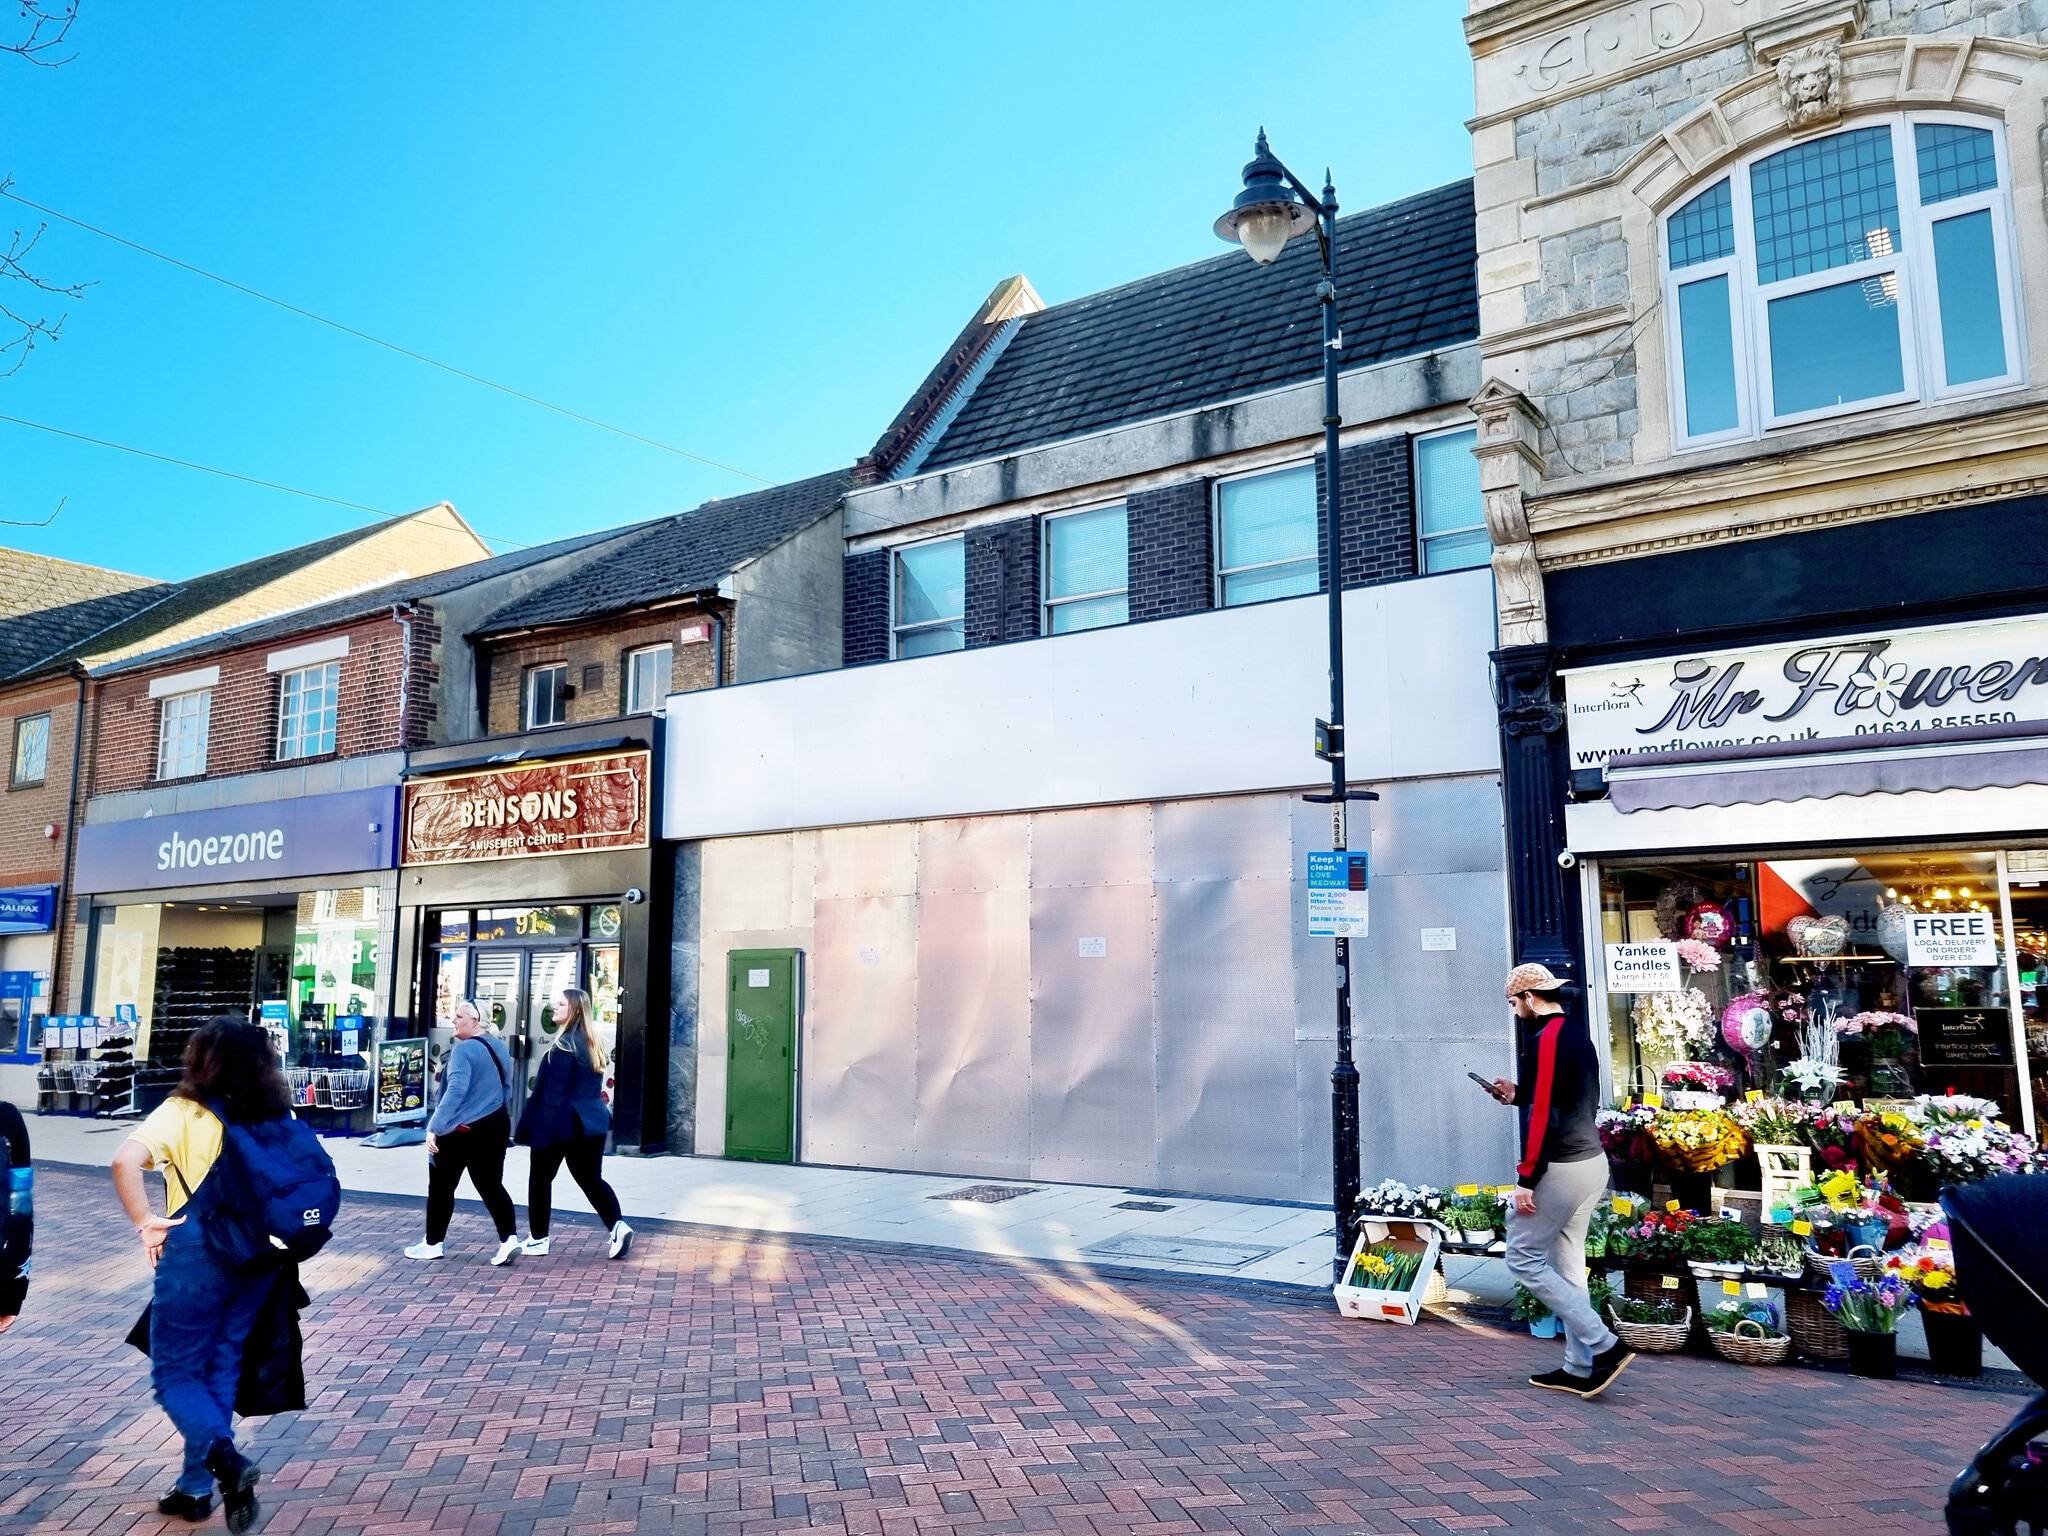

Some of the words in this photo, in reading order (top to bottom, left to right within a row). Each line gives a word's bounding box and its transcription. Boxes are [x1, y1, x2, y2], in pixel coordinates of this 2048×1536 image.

[1636, 661, 1765, 735] Mr
[1573, 699, 1631, 715] Interflora
[1576, 727, 1821, 764] wwwmrflowercouk
[461, 788, 579, 829] BENSONS
[470, 836, 525, 851] AMUSEMENT
[527, 833, 565, 847] CENTRE
[157, 828, 284, 871] shoezone
[1310, 855, 1333, 864] Keep
[1336, 855, 1343, 863] it
[0, 904, 39, 913] HALIFAX
[516, 910, 539, 935] 91
[1913, 918, 1985, 937] FREE
[1914, 939, 1943, 947] LOCAL
[1945, 938, 1987, 946] DELIVERY
[1616, 945, 1666, 956] Yankee
[1941, 946, 1977, 954] ORDERS
[1614, 959, 1671, 971] Candles
[1616, 973, 1640, 981] Large
[1942, 1023, 1977, 1031] Interflora
[1935, 1042, 1968, 1050] Interflora
[303, 1208, 320, 1220] CG
